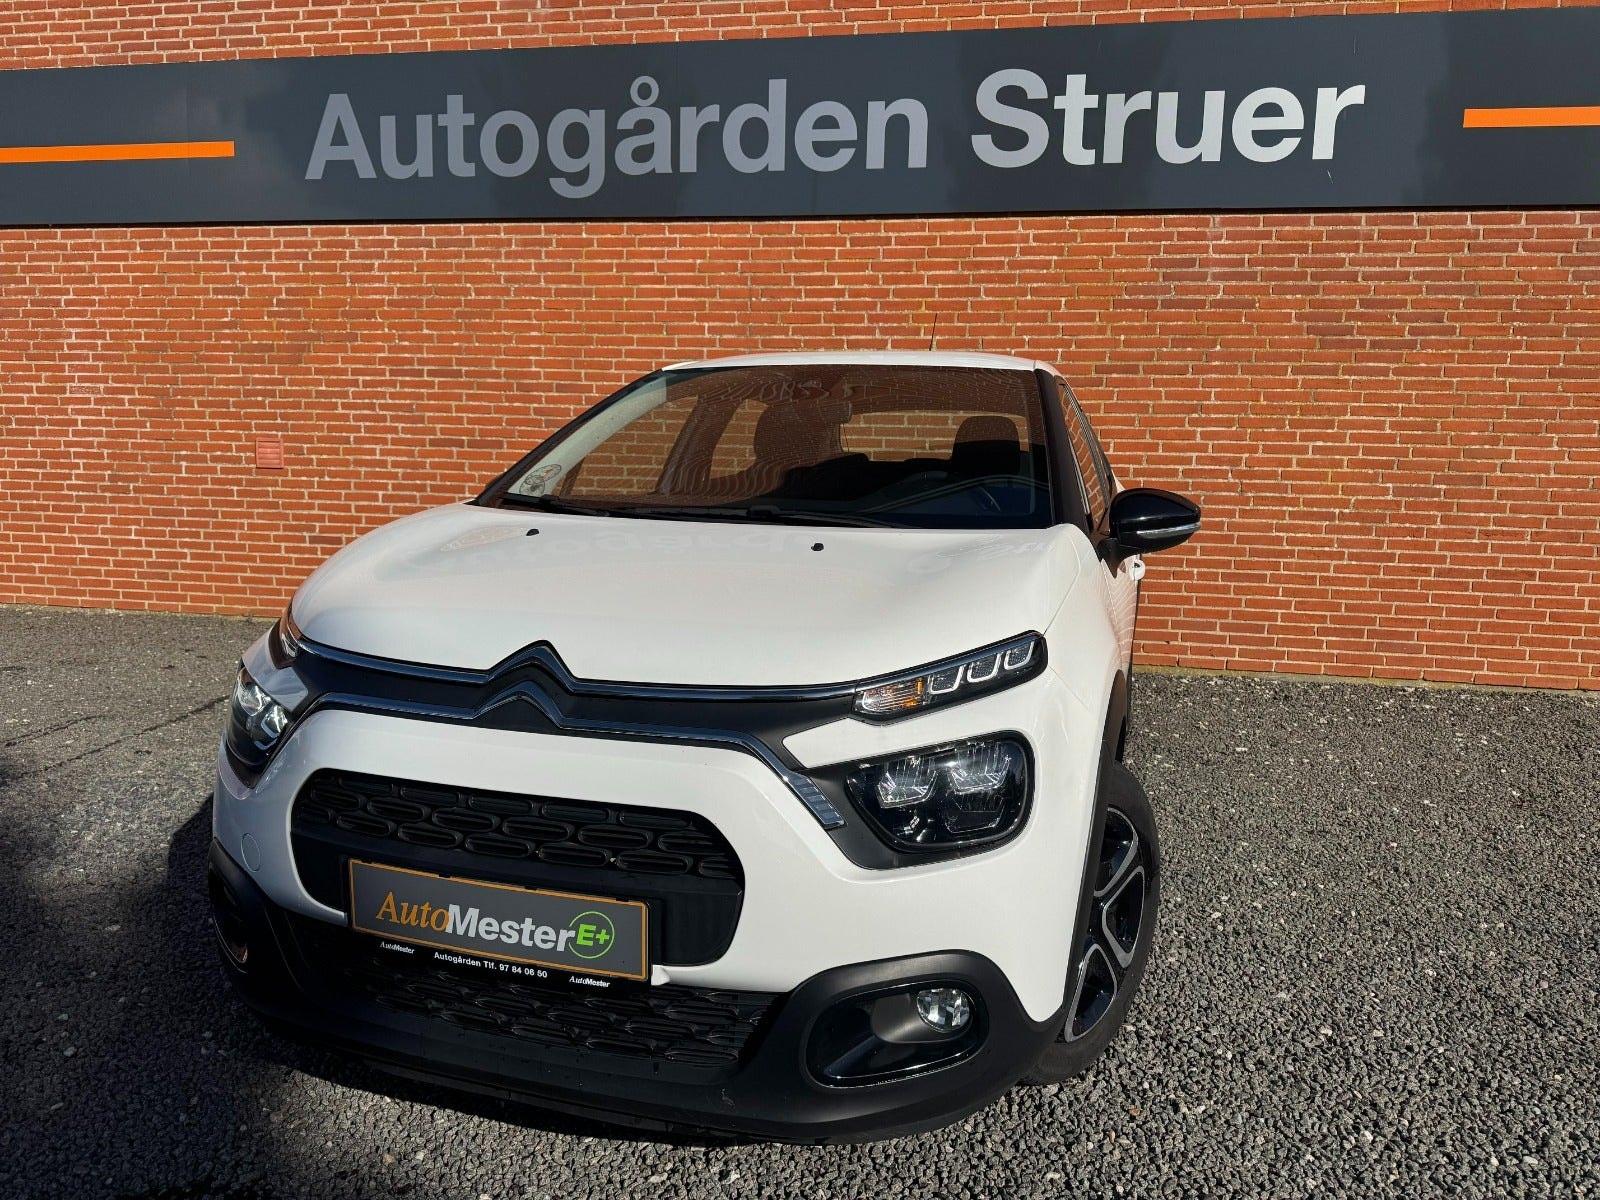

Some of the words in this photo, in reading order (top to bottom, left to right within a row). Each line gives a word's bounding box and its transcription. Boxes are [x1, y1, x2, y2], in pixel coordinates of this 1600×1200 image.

[305, 75, 929, 199] Autogården
[971, 69, 1366, 169] Struer
[375, 891, 576, 952] AutoMester
[577, 923, 610, 946] E+
[434, 952, 481, 967] Autogården
[483, 960, 498, 970] Tlf.
[499, 963, 510, 972] 97
[511, 965, 522, 974] 84
[524, 967, 535, 976] 06
[569, 976, 610, 988] AutoMester
